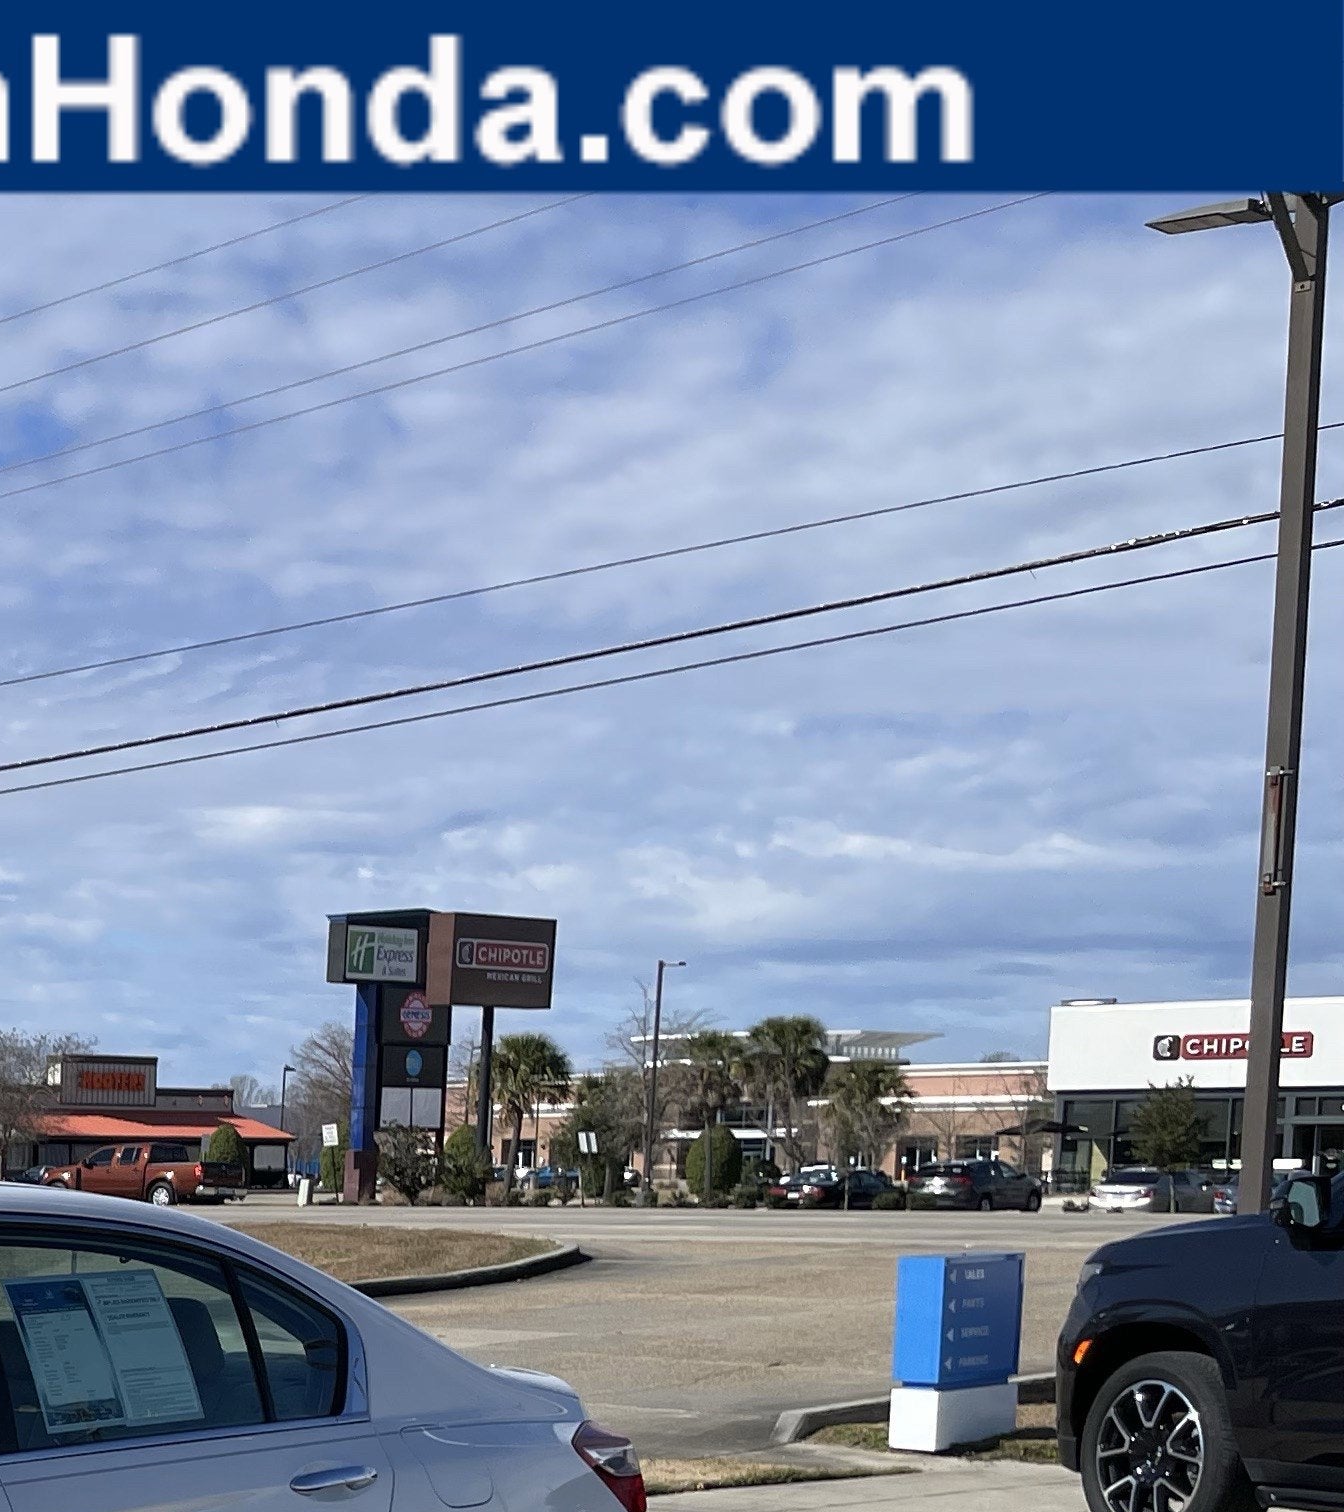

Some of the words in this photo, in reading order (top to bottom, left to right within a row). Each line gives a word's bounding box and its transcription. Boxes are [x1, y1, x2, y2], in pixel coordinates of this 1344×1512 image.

[376, 945, 414, 963] Express
[478, 946, 544, 966] CHIPOTLE
[486, 972, 520, 981] MEXICAN
